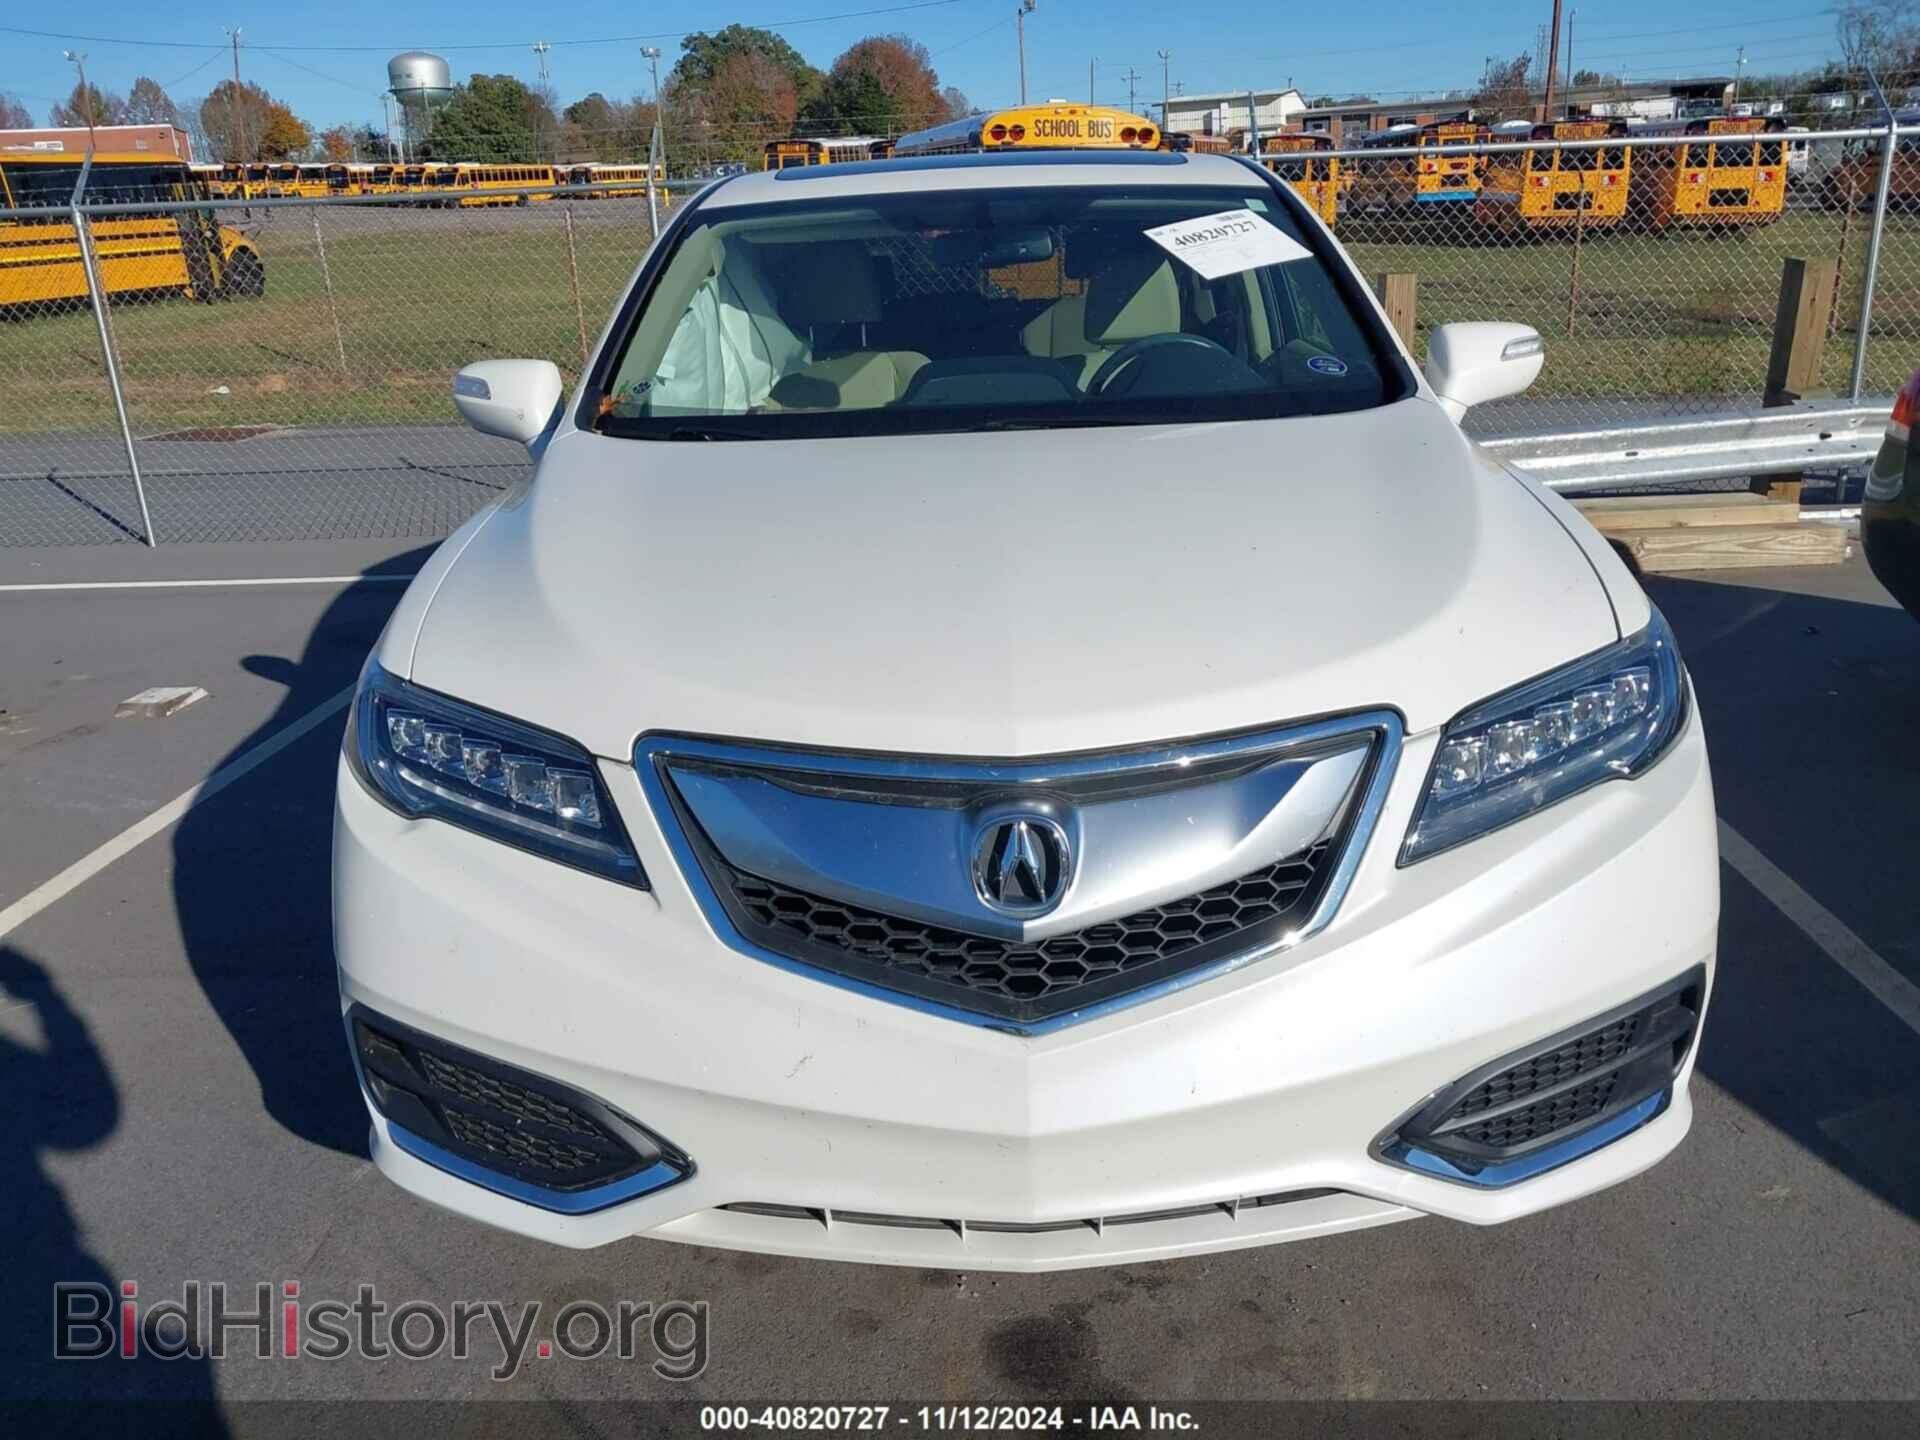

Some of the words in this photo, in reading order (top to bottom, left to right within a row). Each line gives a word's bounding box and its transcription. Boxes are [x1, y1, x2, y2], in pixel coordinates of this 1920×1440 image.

[1034, 118, 1082, 138] SCHOOL
[1088, 119, 1112, 138] BUS
[1174, 220, 1257, 246] 40820727
